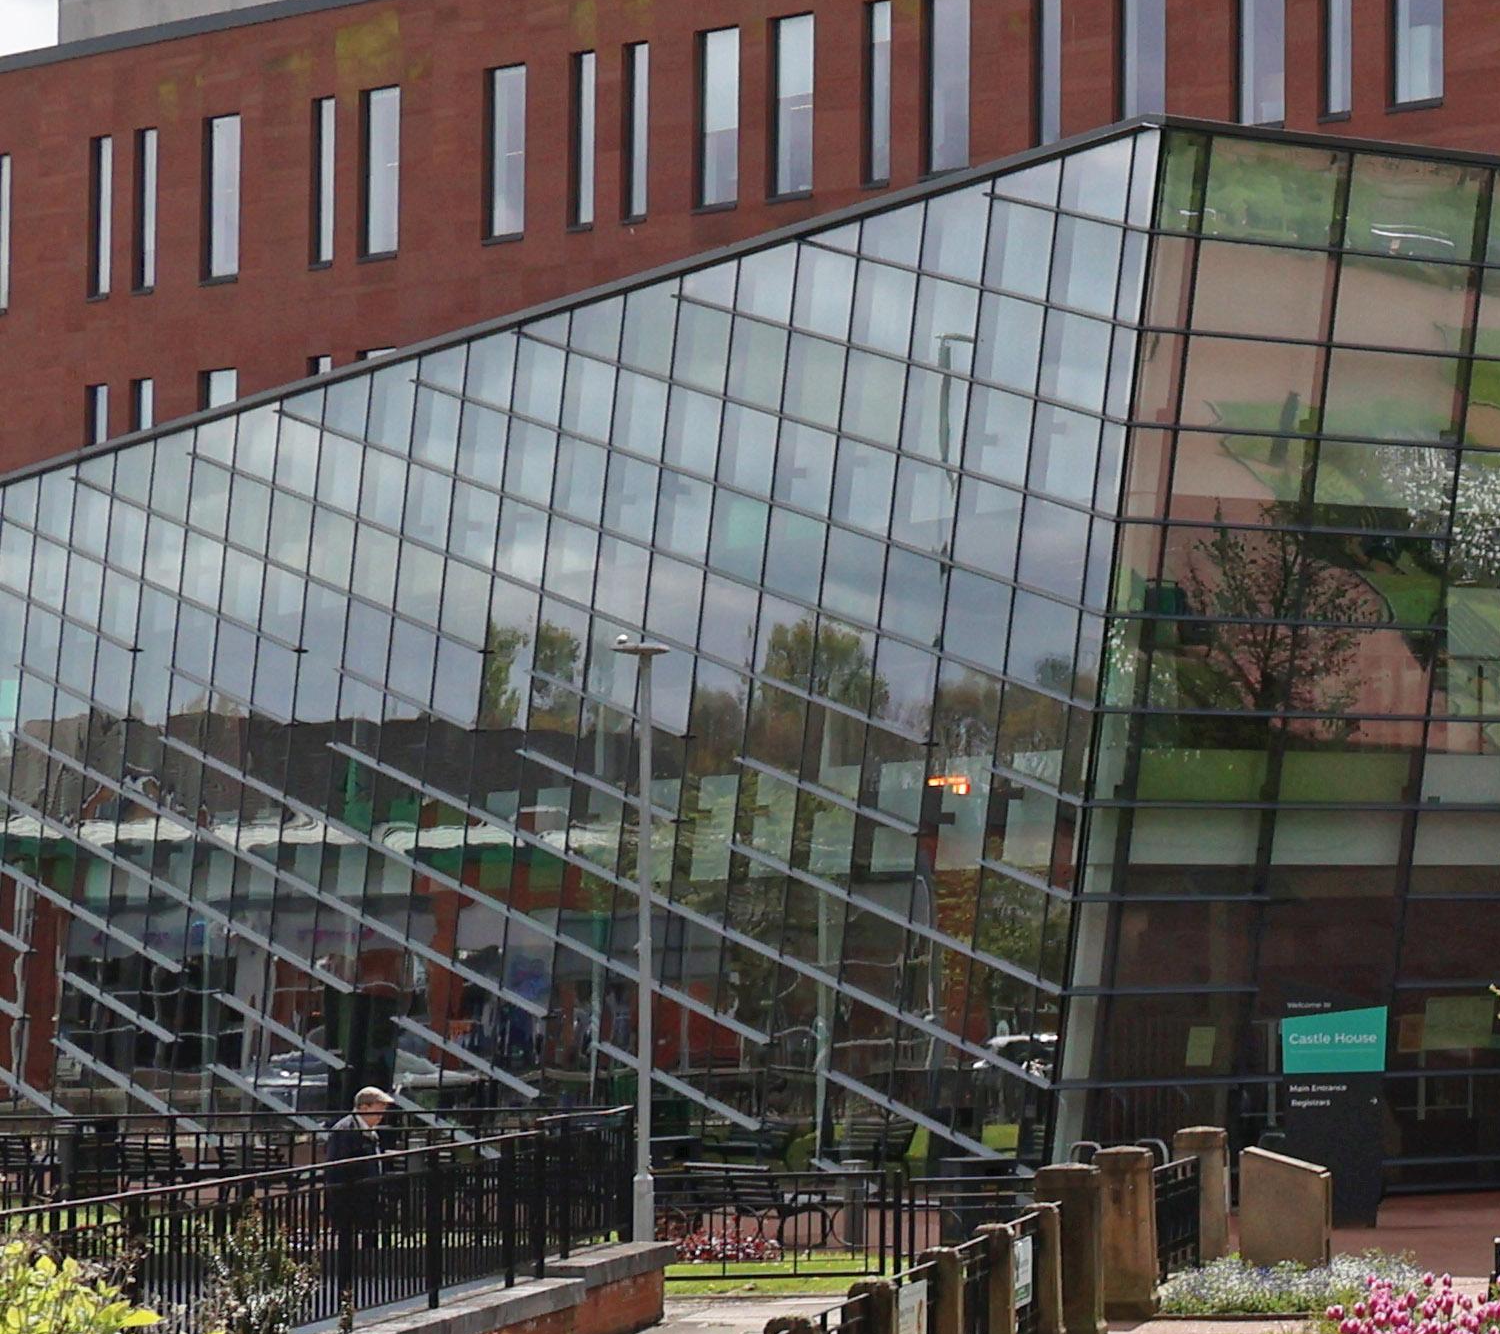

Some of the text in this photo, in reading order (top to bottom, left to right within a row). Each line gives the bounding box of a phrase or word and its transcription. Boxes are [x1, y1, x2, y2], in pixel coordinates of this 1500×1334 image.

[1289, 1032, 1378, 1045] Castle House
[1289, 1084, 1348, 1093] Main Entrance
